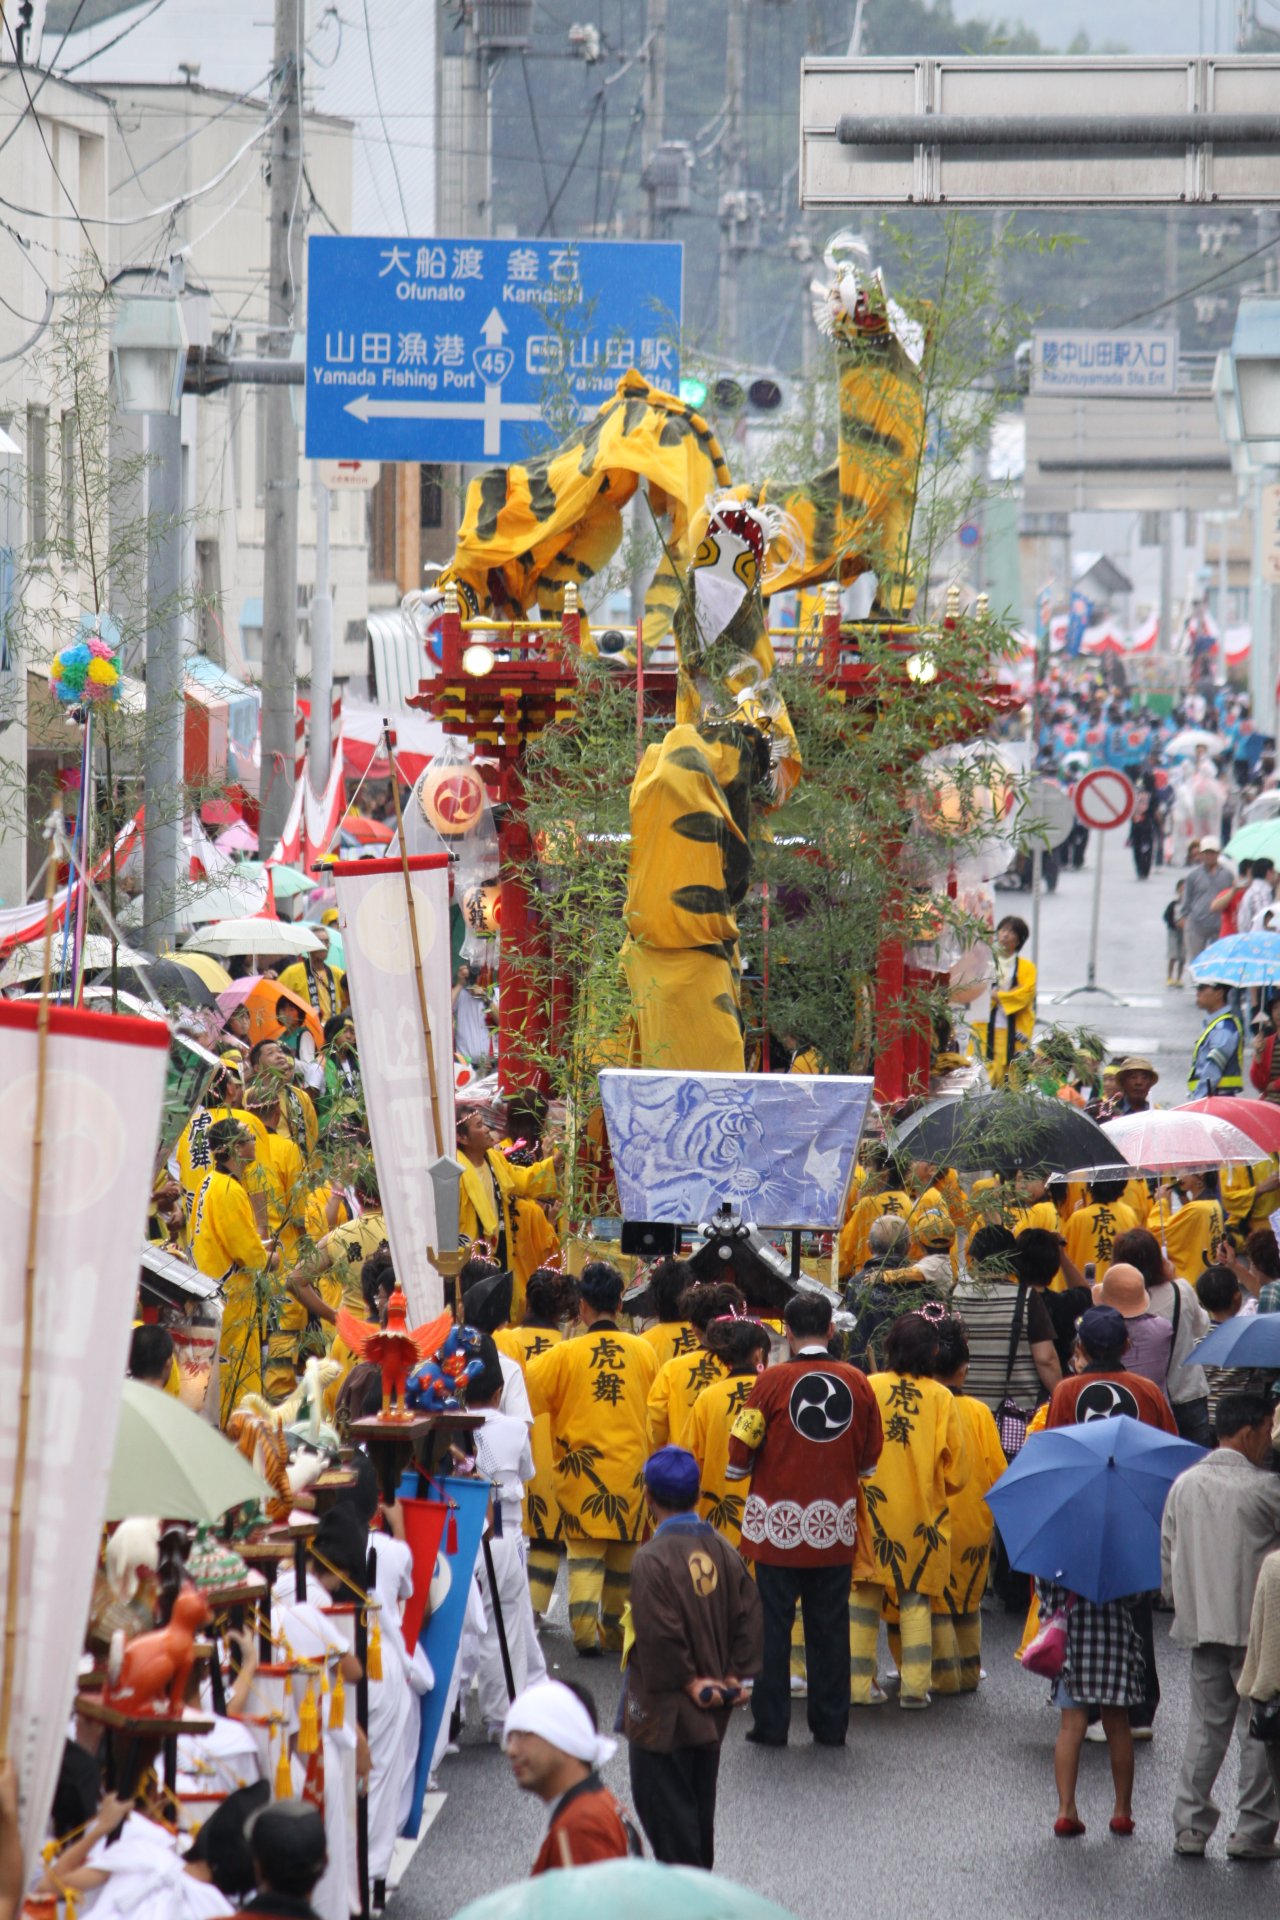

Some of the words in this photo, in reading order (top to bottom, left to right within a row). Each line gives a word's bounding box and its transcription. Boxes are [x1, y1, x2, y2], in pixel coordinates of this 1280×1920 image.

[379, 245, 484, 281] 大船渡
[507, 248, 580, 281] 釜石
[396, 281, 465, 301] Ofunato
[325, 331, 465, 367] 山田漁港
[481, 353, 506, 374] 45
[569, 335, 673, 370] 山田駅
[313, 367, 376, 386] Yamada
[382, 368, 438, 391] Fishing
[443, 371, 476, 389] Port
[1092, 1207, 1117, 1263] 虎舞
[588, 1337, 626, 1408] 虎舞
[885, 1378, 923, 1451] 虎舞
